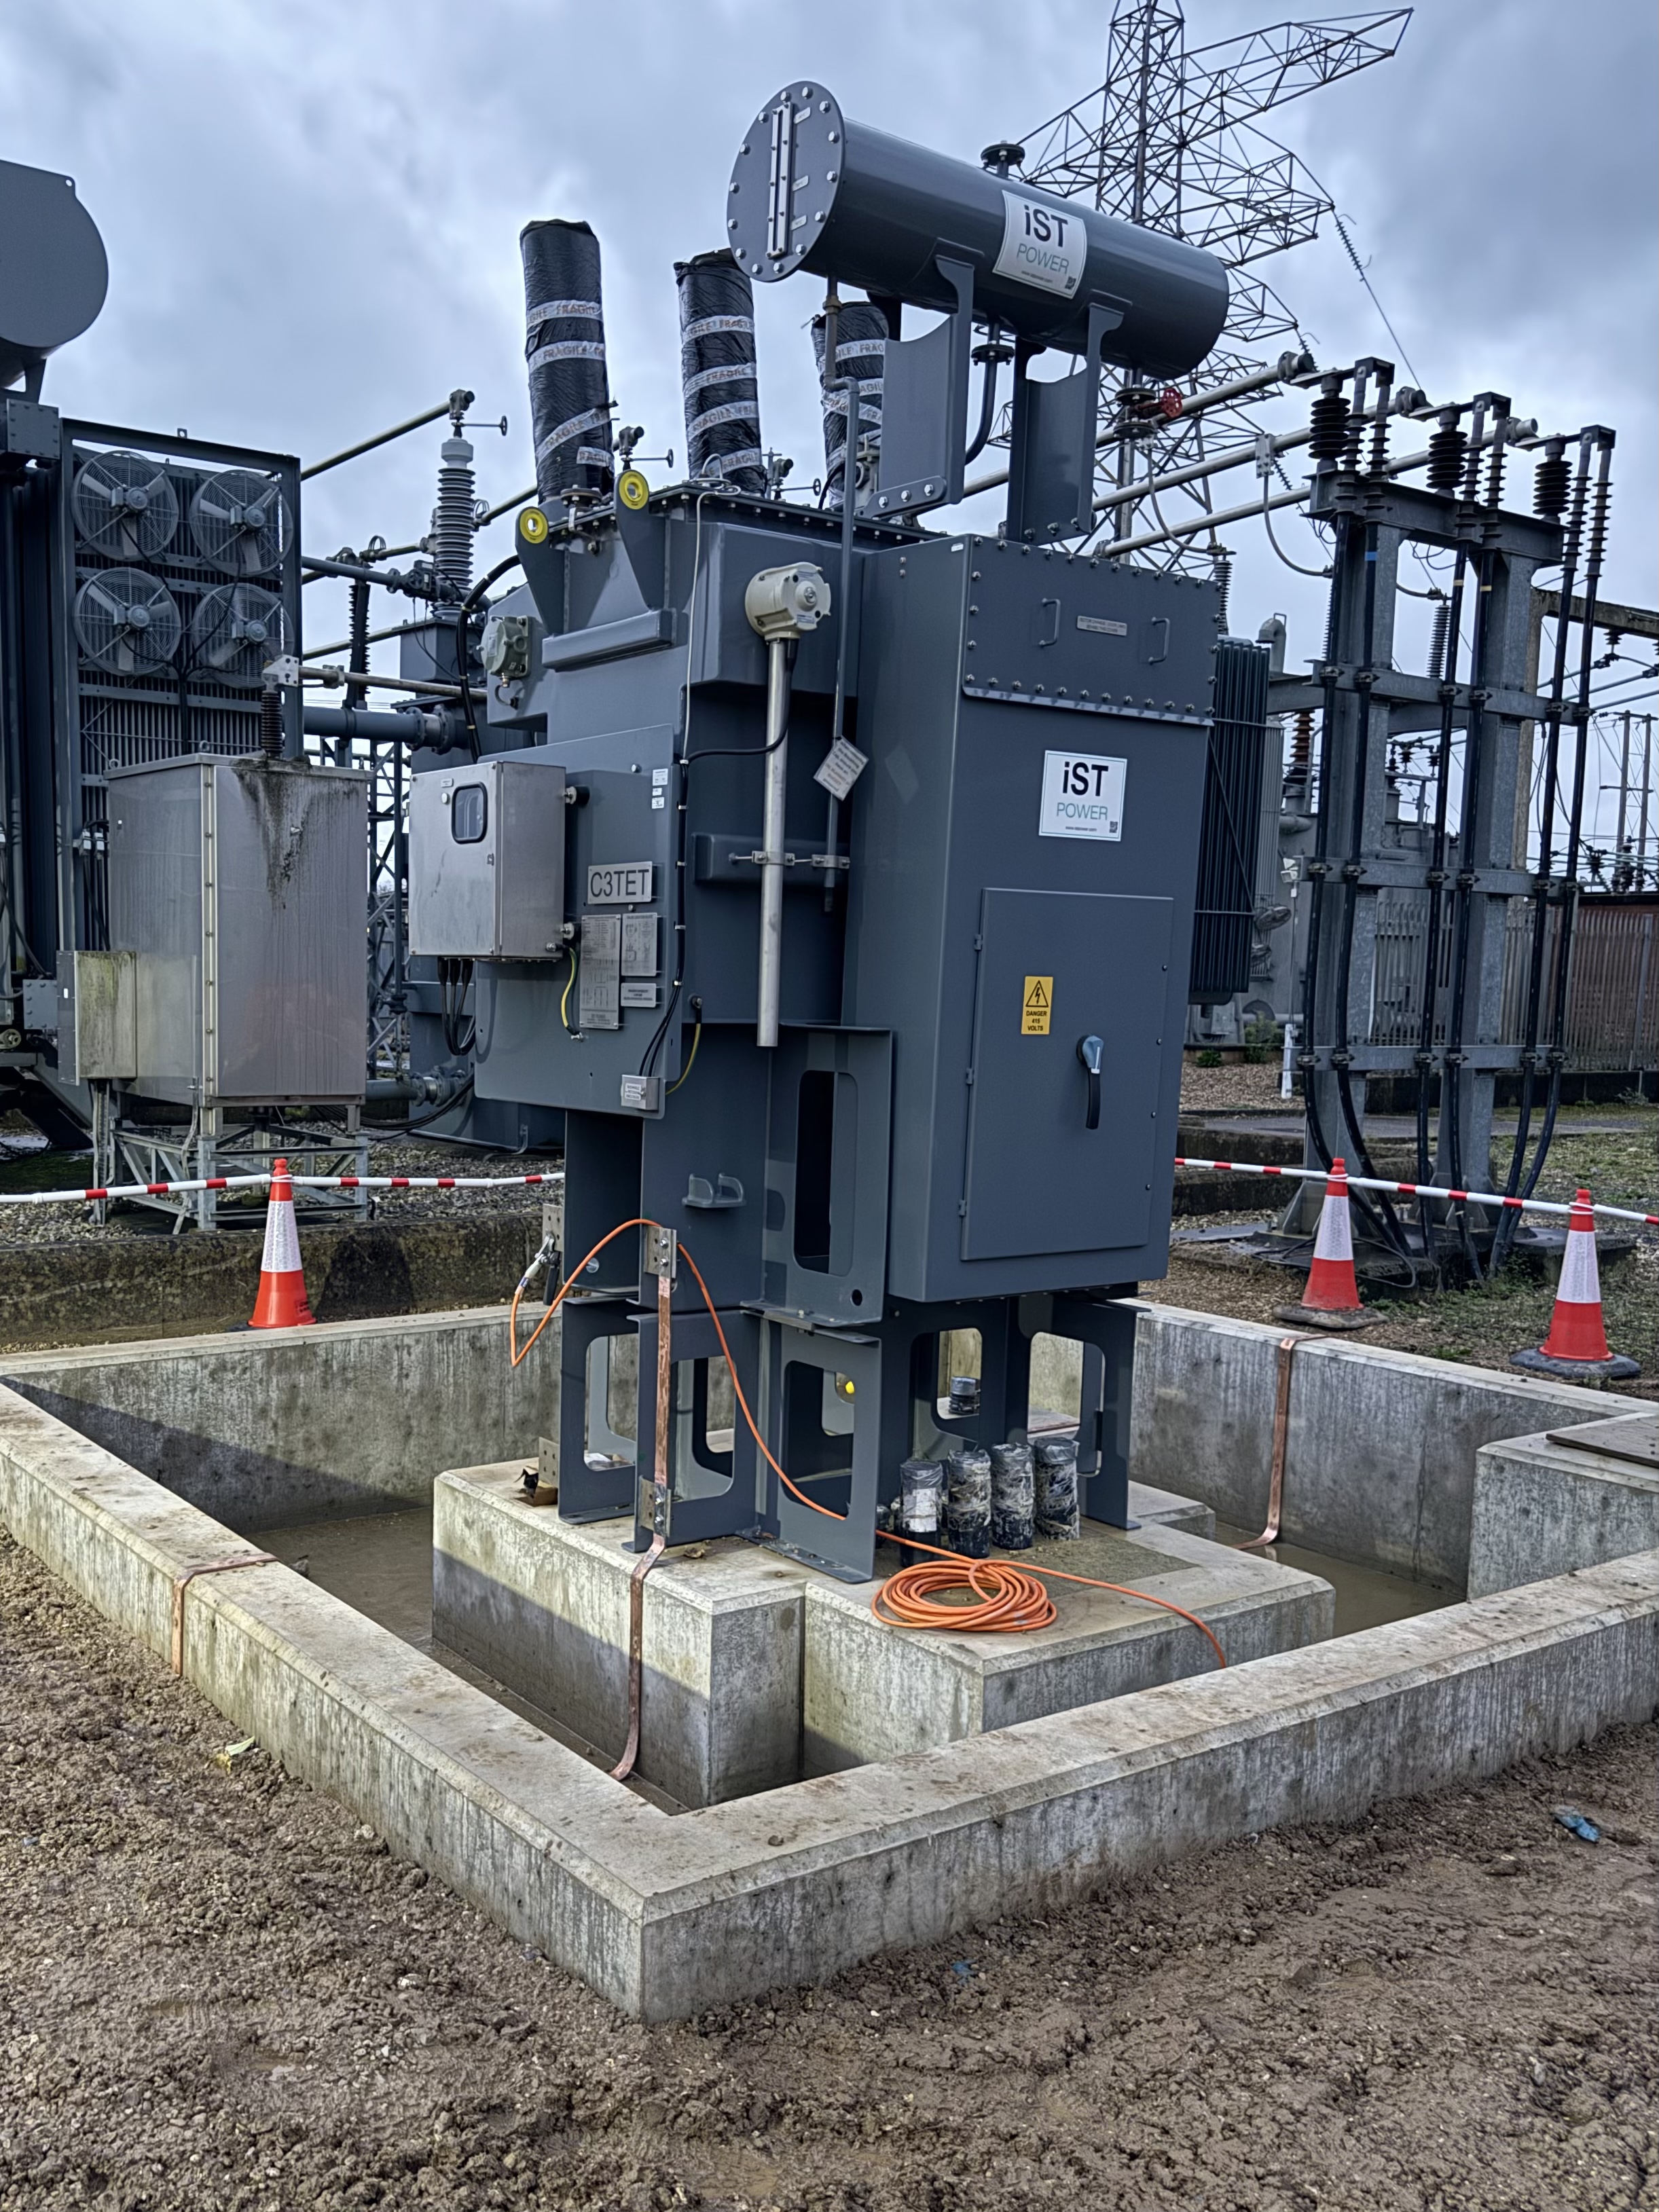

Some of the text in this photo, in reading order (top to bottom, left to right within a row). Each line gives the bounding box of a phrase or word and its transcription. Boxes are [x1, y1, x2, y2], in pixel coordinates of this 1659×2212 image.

[1023, 204, 1068, 248] iST
[1016, 243, 1070, 274] POWER
[1062, 761, 1109, 797] iST
[1056, 802, 1108, 821] POWER
[590, 869, 649, 898] C3TET
